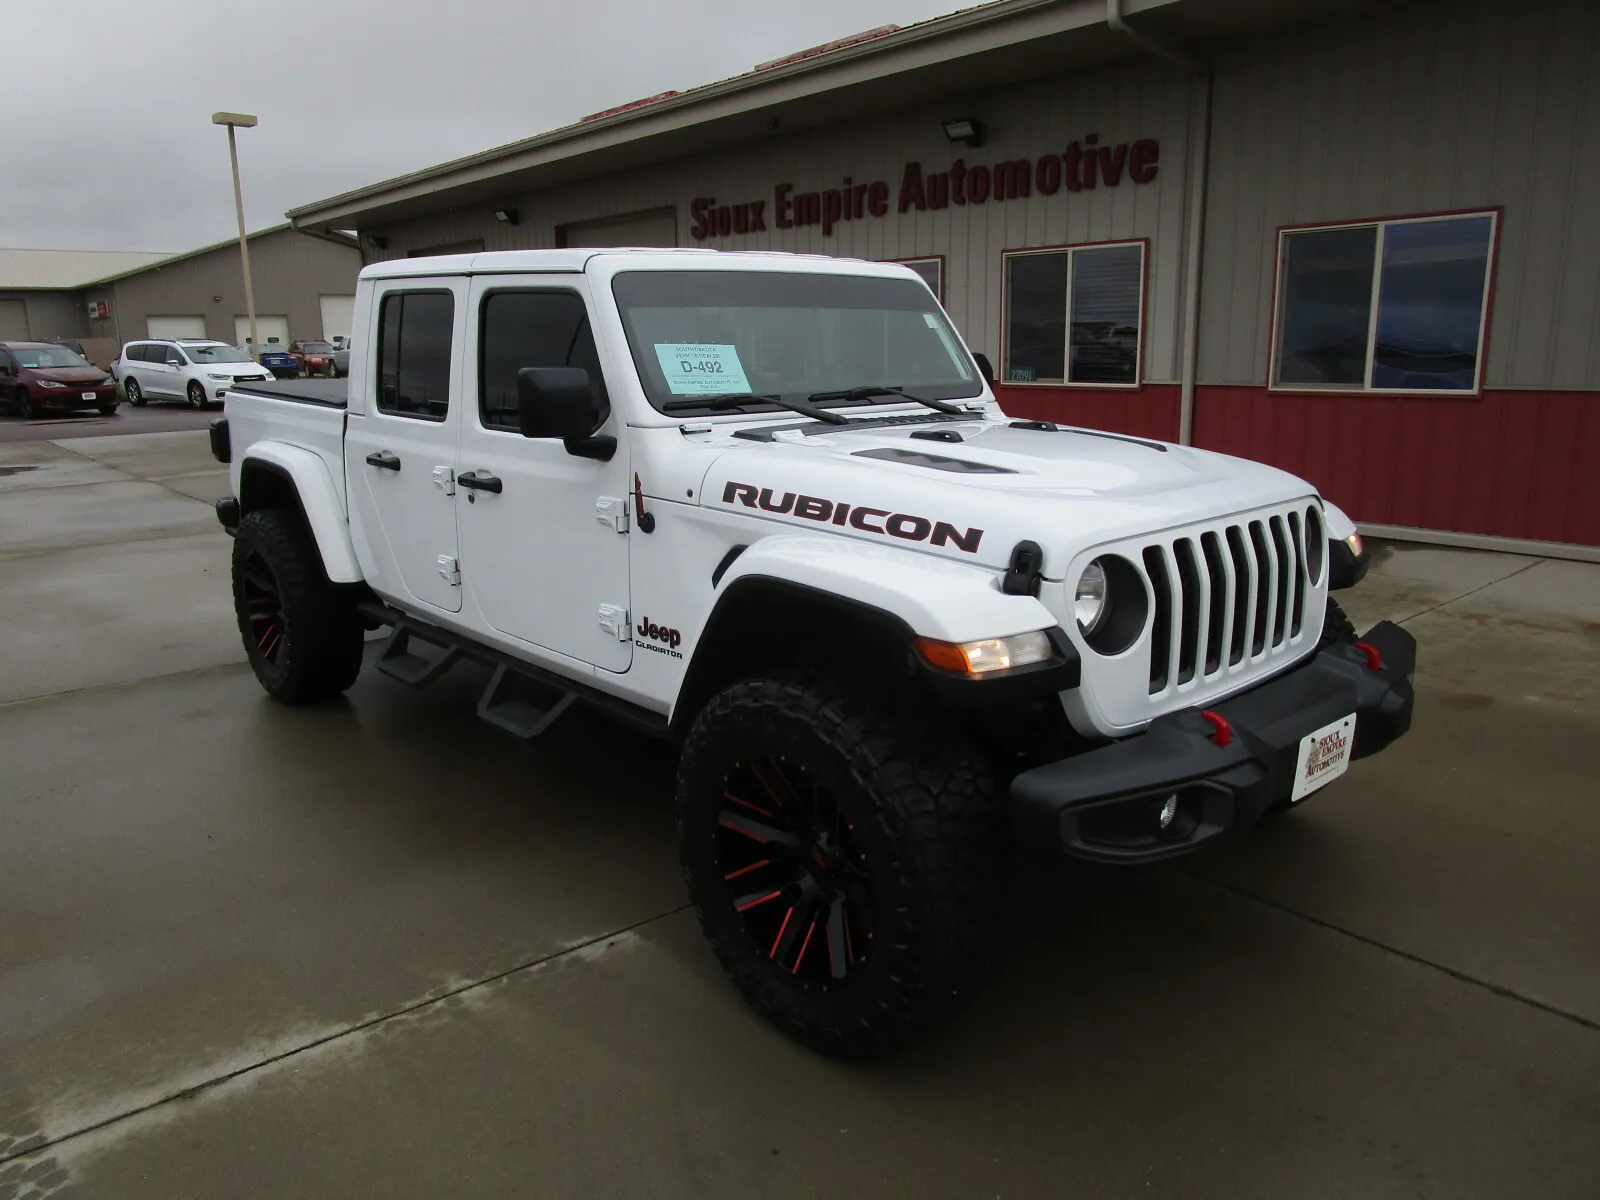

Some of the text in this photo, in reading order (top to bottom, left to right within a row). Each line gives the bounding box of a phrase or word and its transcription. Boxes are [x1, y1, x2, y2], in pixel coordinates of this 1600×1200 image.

[690, 135, 1160, 240] Sioux Empire Automotive
[680, 360, 723, 373] D-492
[722, 480, 984, 554] RUBICON
[637, 616, 681, 649] Jeep
[635, 639, 683, 660] GLADIATOR
[1319, 731, 1340, 749] SIOUX
[1321, 737, 1347, 758] EMPIRE
[1306, 749, 1345, 777] AUTOMOTIVE
